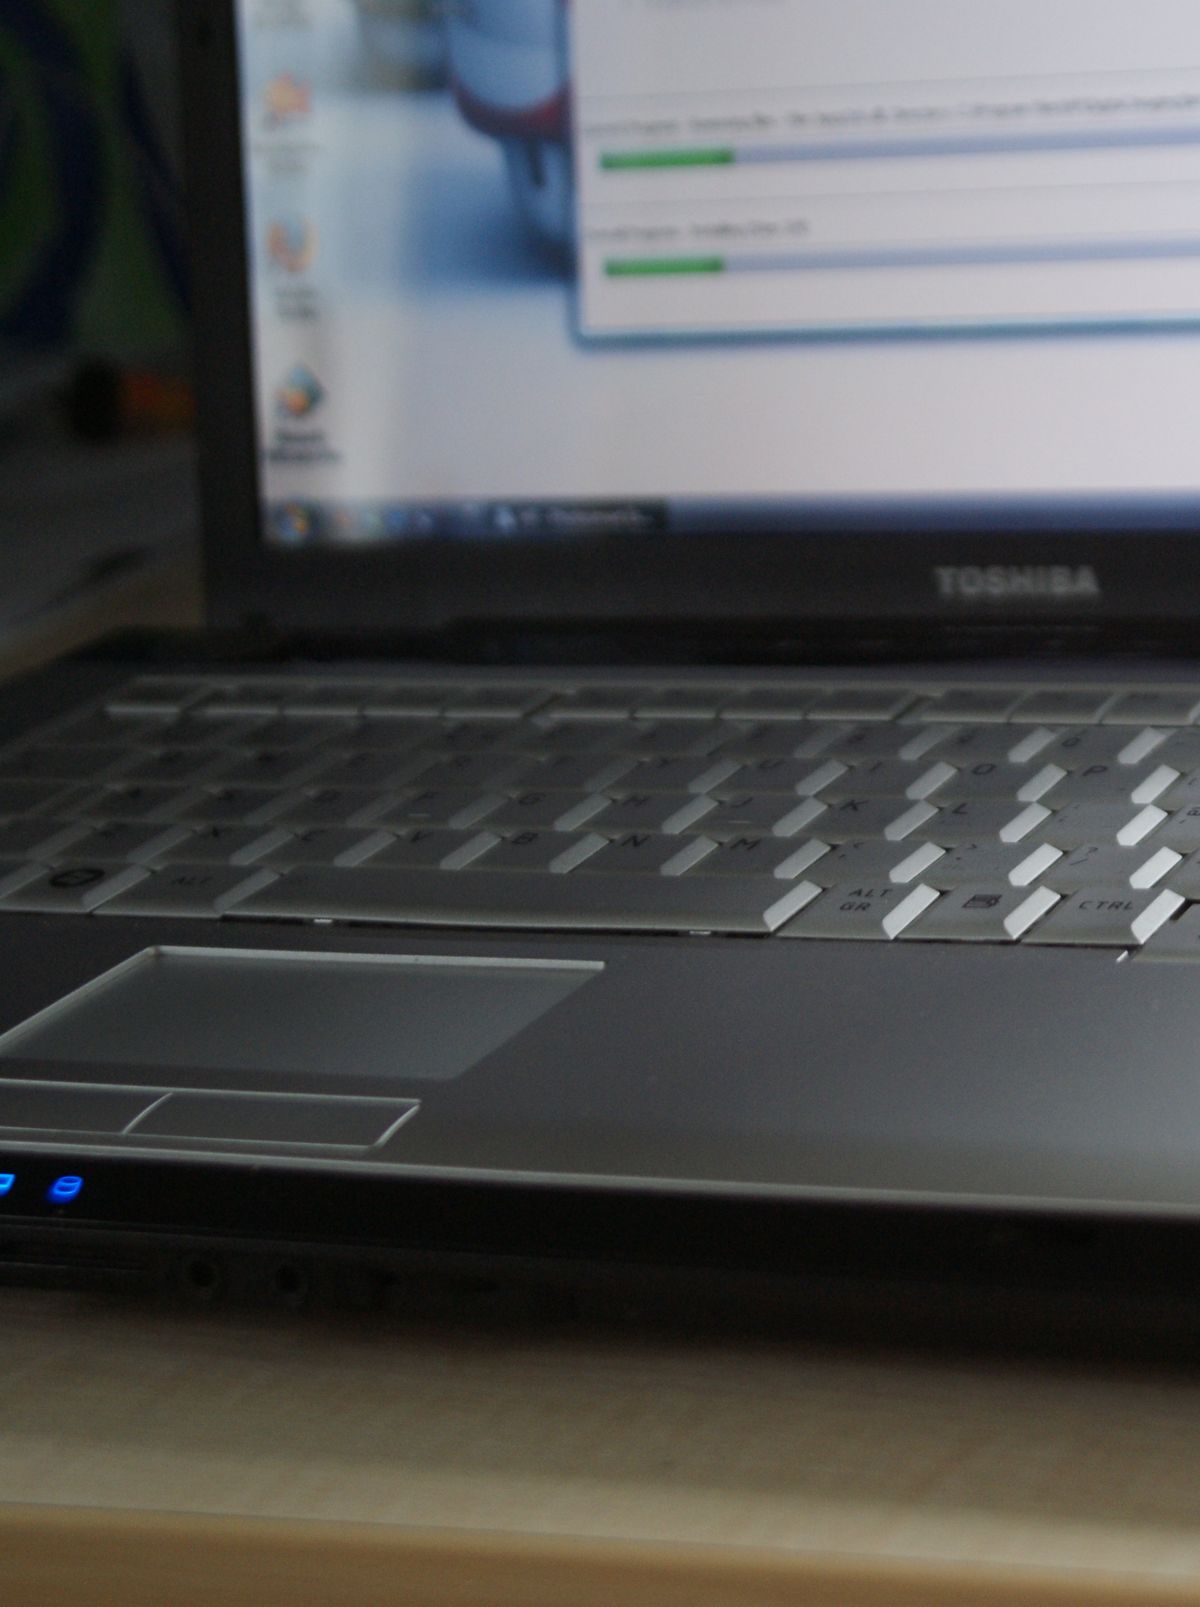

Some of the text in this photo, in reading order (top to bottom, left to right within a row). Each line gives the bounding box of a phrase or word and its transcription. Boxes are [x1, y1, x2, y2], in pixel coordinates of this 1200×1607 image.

[934, 564, 1100, 594] TOSHIBA
[1083, 765, 1109, 776] P
[848, 888, 894, 898] ALT
[838, 901, 873, 912] GR
[1078, 900, 1136, 910] CTRL
